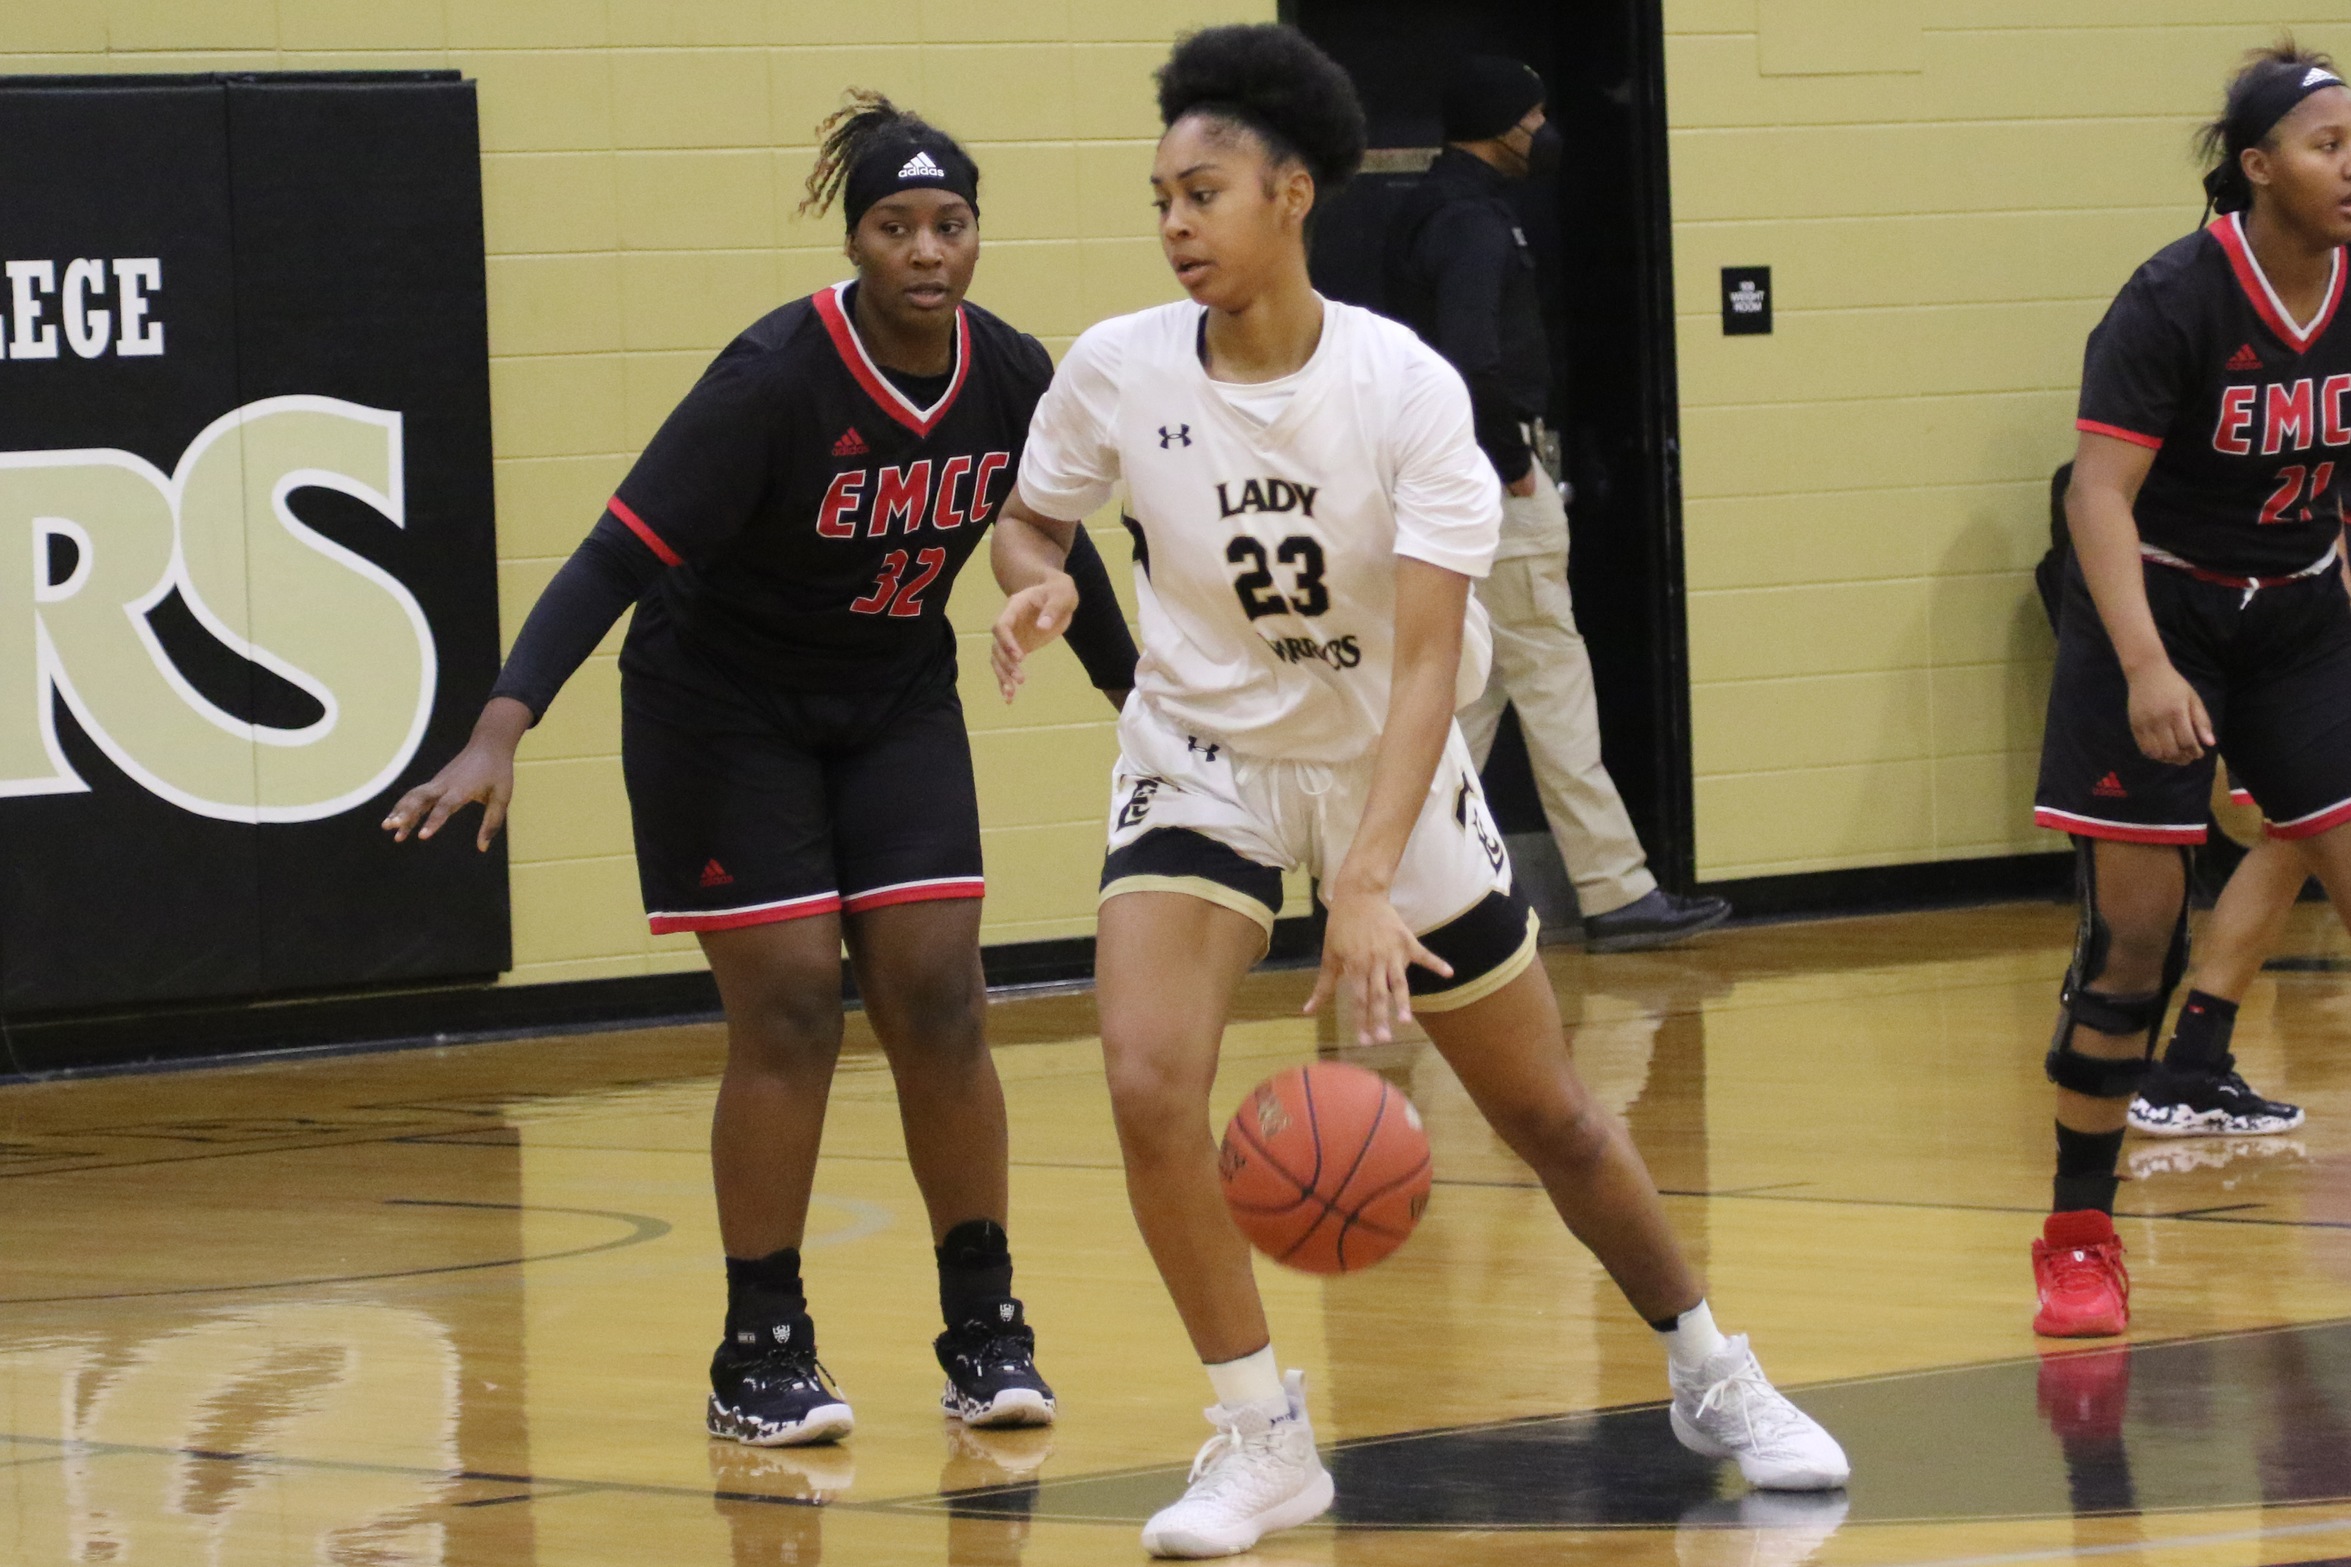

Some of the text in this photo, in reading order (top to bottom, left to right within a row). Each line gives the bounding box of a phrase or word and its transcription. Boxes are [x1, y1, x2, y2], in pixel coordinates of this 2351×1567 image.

[897, 166, 945, 178] adidas
[0, 256, 165, 361] EGE
[815, 451, 1010, 539] EMCC
[1215, 477, 1320, 520] LADY
[849, 546, 947, 617] 32
[1226, 535, 1331, 622] 23
